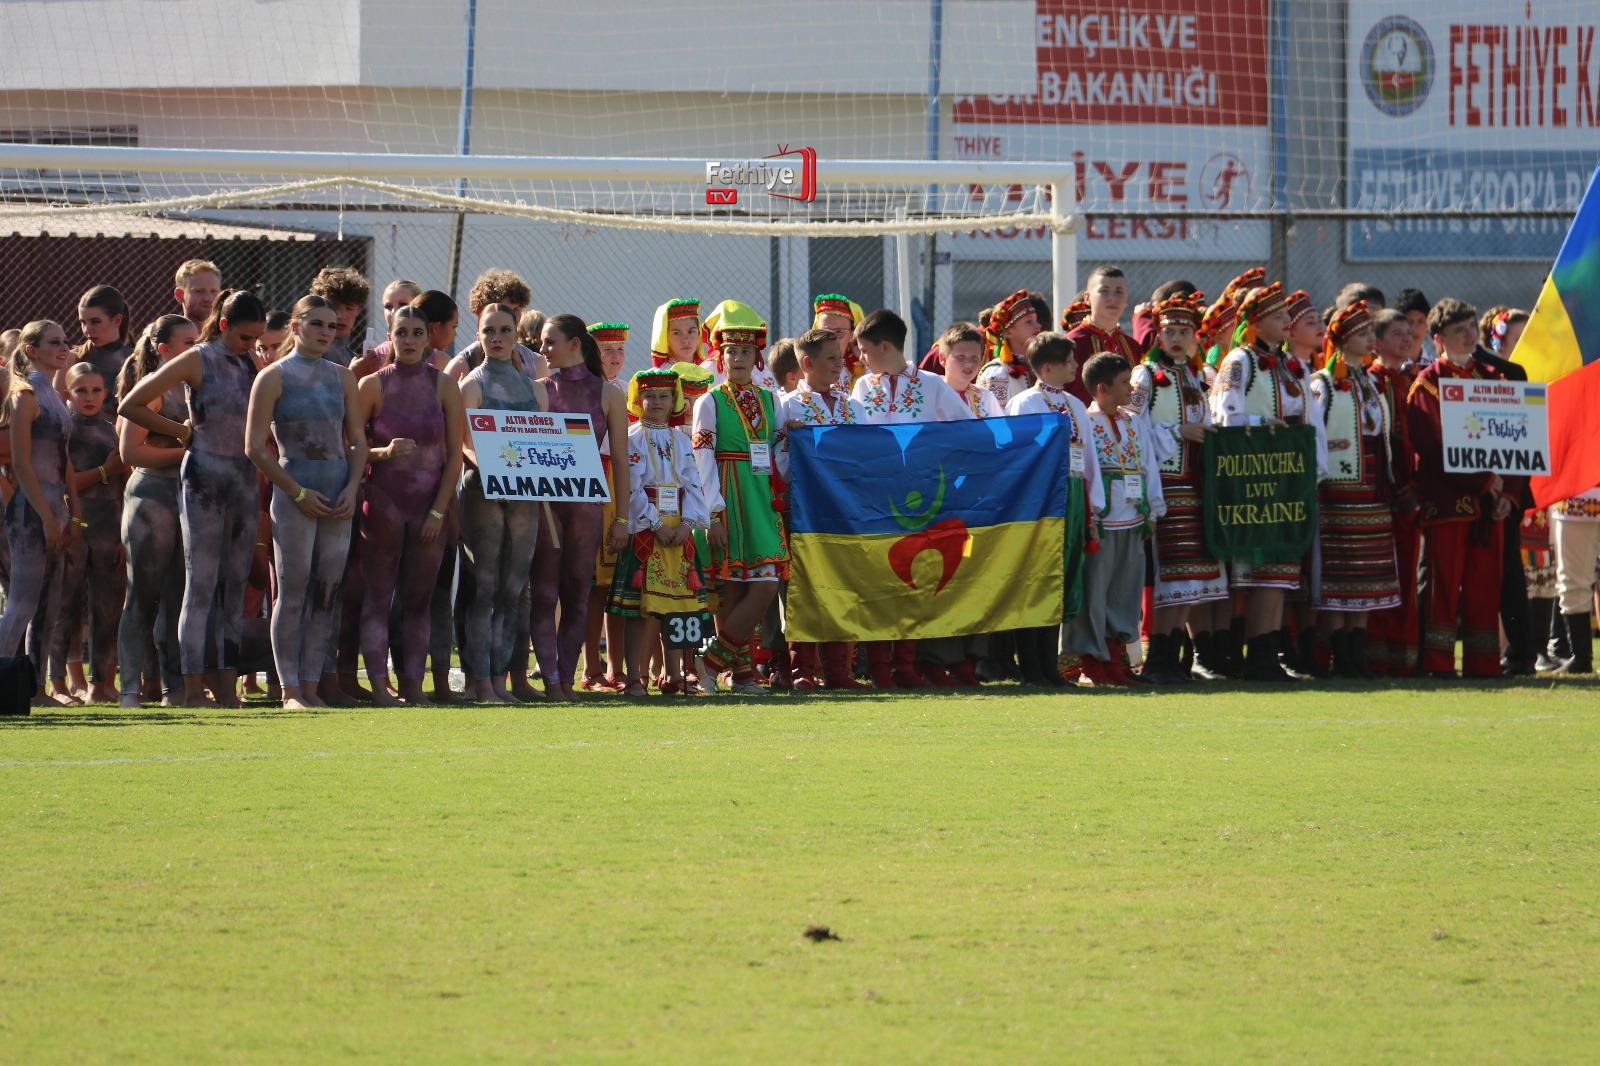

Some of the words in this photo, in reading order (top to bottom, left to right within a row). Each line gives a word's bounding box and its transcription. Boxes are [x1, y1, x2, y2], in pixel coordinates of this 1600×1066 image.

[1155, 15, 1196, 48] VE
[1449, 0, 1567, 127] FETHİYE
[1577, 25, 1600, 127] K
[1041, 65, 1216, 106] BAKANLIĞI
[505, 415, 527, 425] ALTIN
[1215, 452, 1305, 477] POLUNYCHKA
[1447, 446, 1547, 471] UKRAYNA
[486, 474, 608, 498] ALMANYA
[1245, 482, 1278, 498] LVIV
[1217, 501, 1307, 526] UKRAINE
[669, 616, 701, 643] 38
